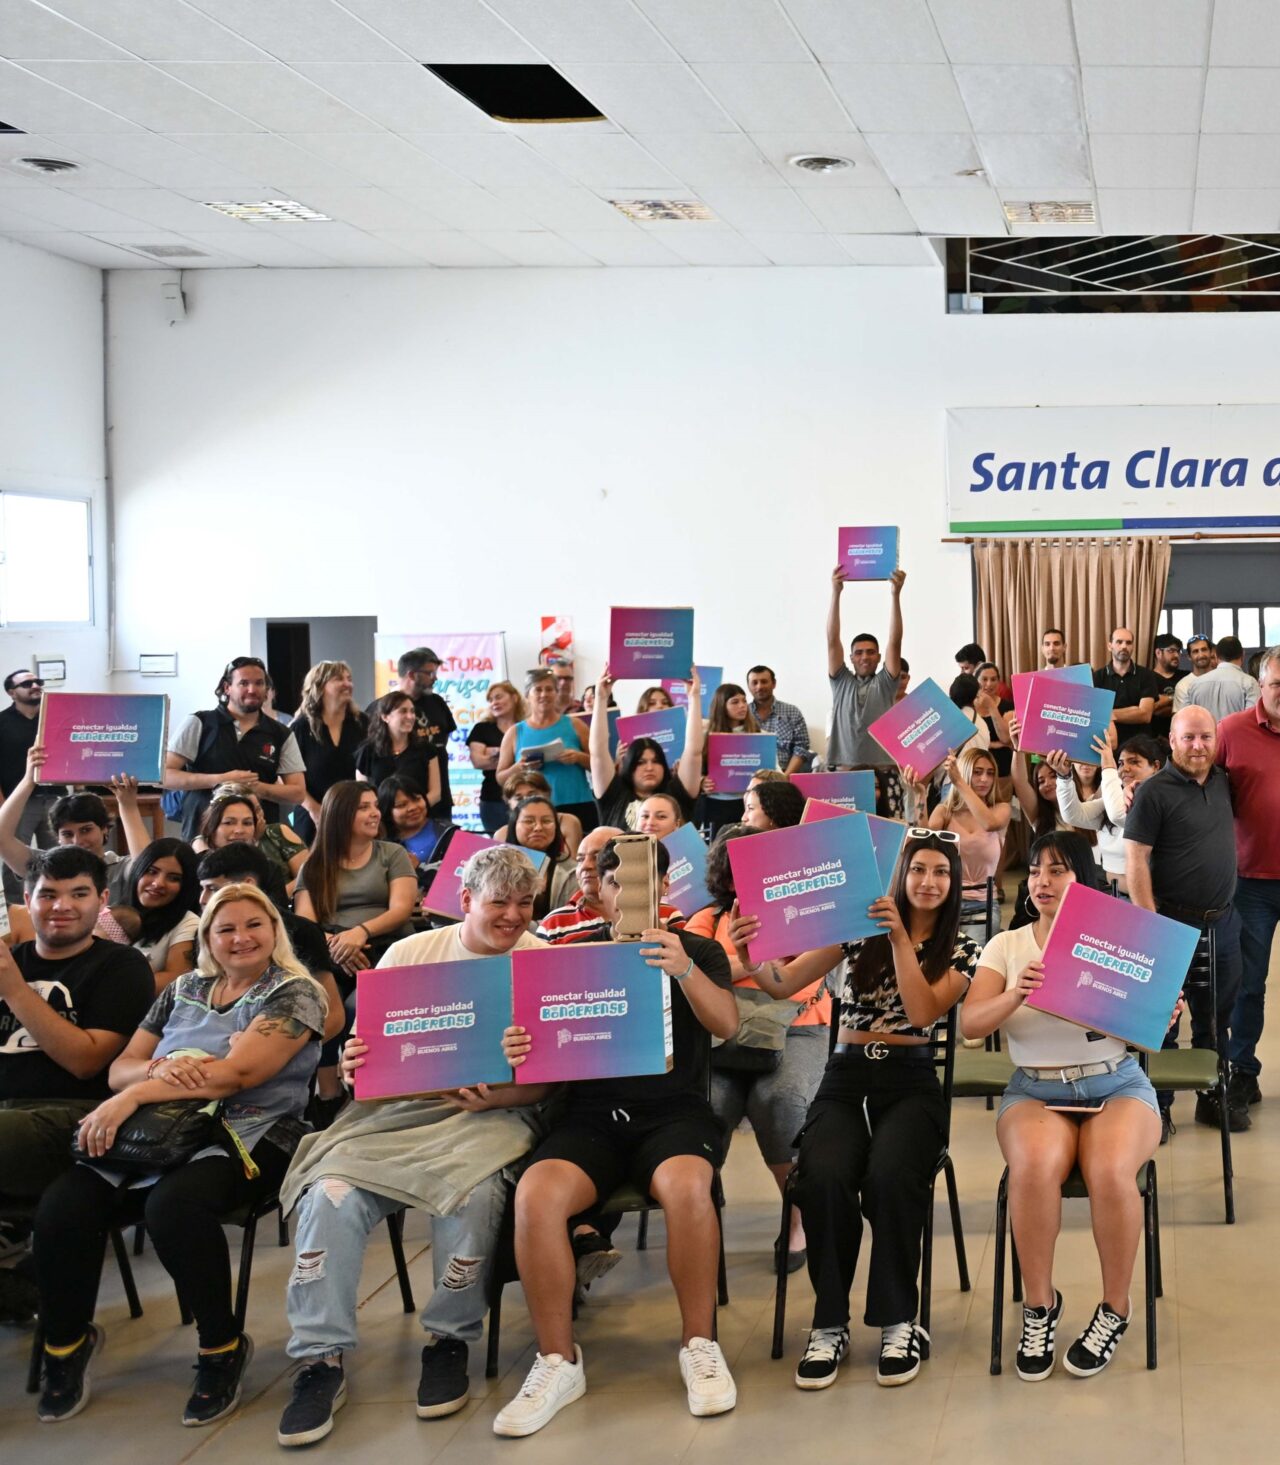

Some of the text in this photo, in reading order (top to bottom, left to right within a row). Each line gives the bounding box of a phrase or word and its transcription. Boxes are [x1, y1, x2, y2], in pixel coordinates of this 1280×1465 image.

[969, 451, 1110, 492] Santa
[1125, 446, 1249, 488] Clara
[106, 724, 138, 732] igualdad
[763, 859, 842, 884] conectar igualdad
[1080, 933, 1155, 967] conectar igualdad
[541, 988, 626, 1002] conectar igualdad
[386, 1001, 474, 1018] conectar igualdad
